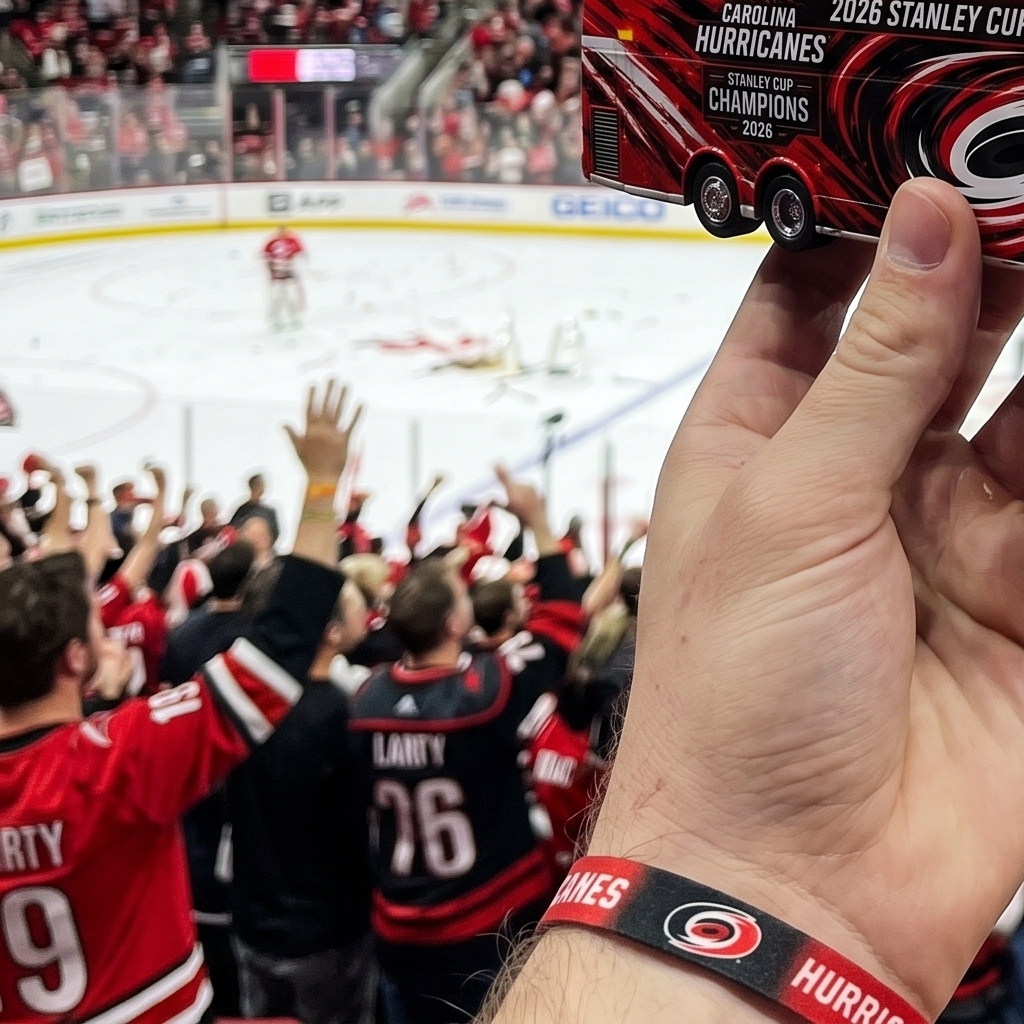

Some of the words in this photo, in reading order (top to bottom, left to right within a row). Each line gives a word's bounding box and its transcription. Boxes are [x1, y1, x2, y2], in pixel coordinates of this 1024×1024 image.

[721, 2, 796, 28] CAROLINA
[887, 0, 983, 34] STANLEY
[694, 24, 827, 64] HURRICANES
[727, 72, 770, 90] STANLEY
[773, 77, 794, 92] CUP
[709, 86, 809, 123] CHAMPIONS
[742, 119, 773, 139] 2026
[0, 886, 88, 1015] 9
